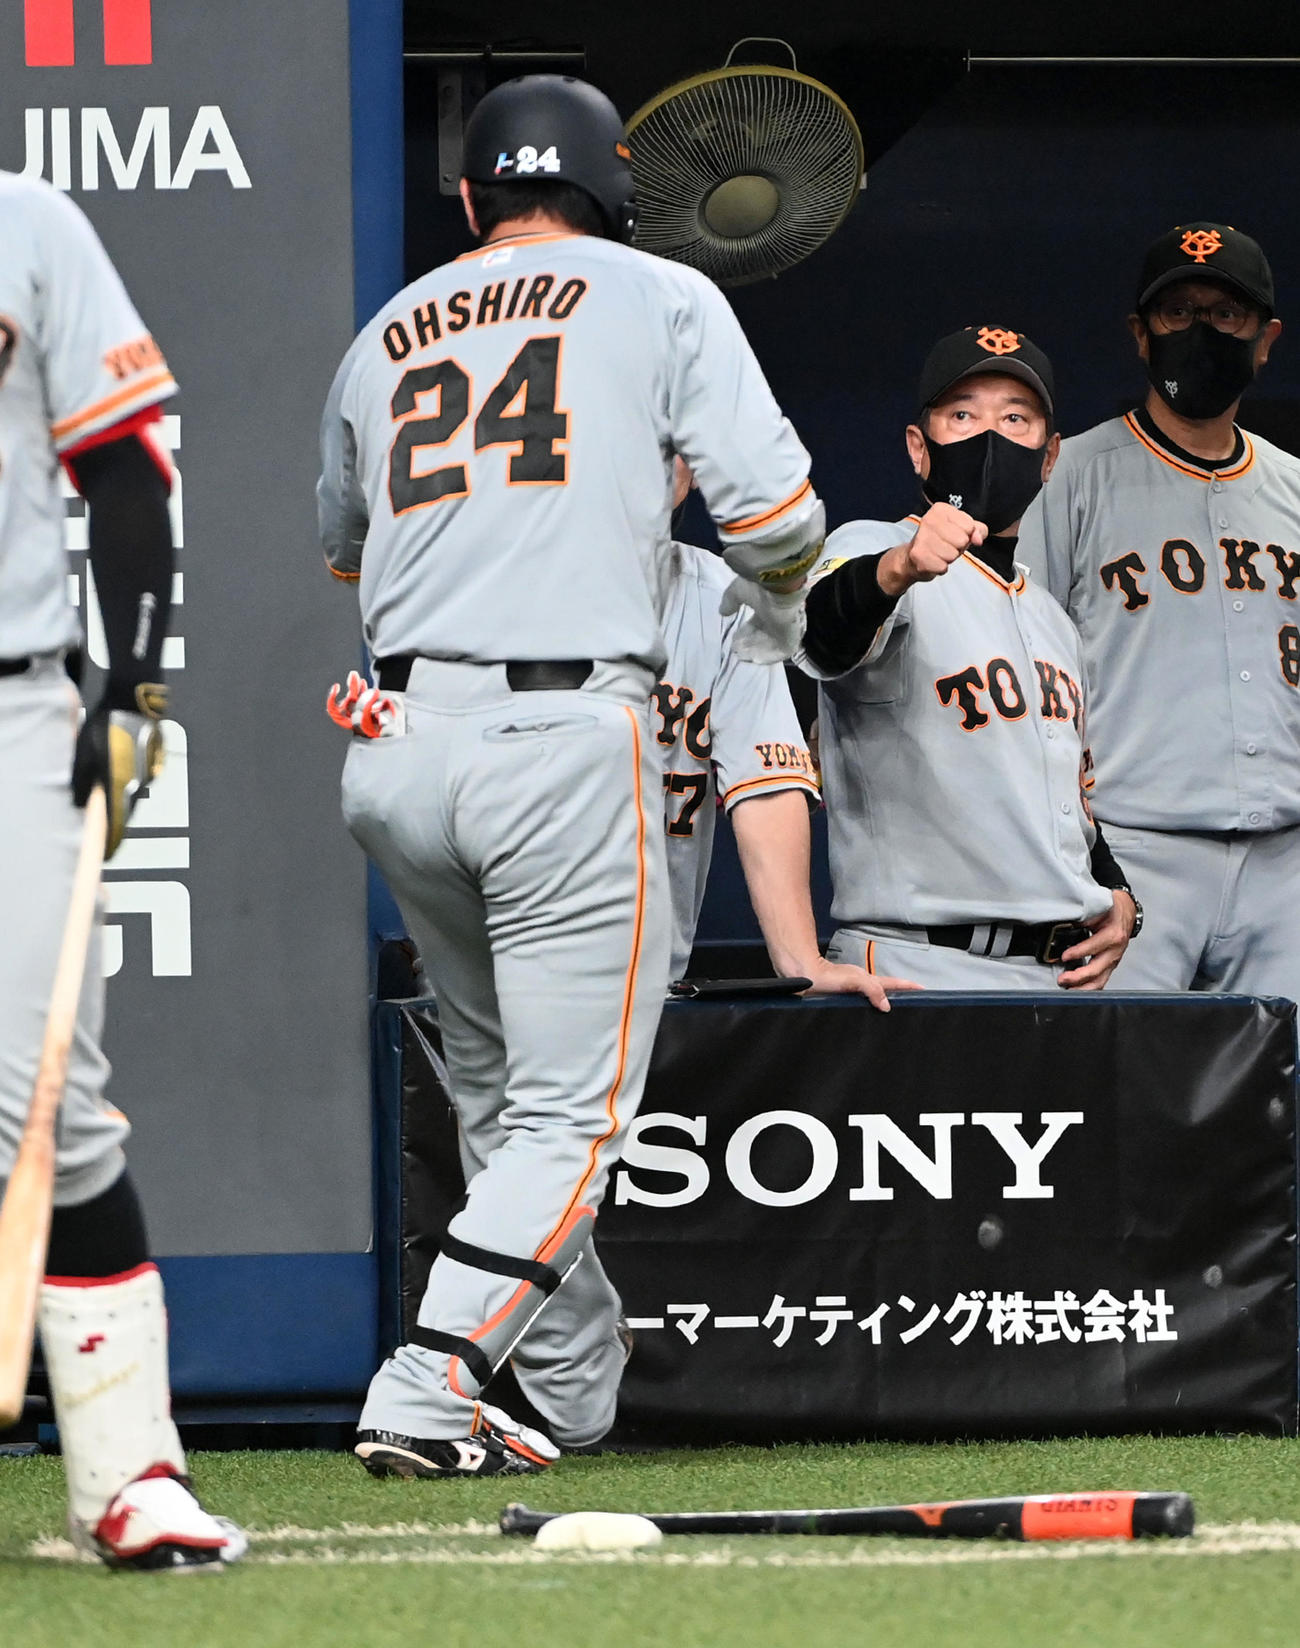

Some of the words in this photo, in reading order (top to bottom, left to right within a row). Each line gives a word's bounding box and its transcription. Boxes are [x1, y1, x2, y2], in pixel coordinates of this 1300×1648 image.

[517, 146, 560, 173] 24
[382, 274, 590, 363] OHSHIRO
[388, 333, 572, 517] 24
[663, 771, 708, 838] 7
[615, 1110, 1084, 1208] SONY
[625, 1288, 1178, 1348] ーマーケティング株式会社
